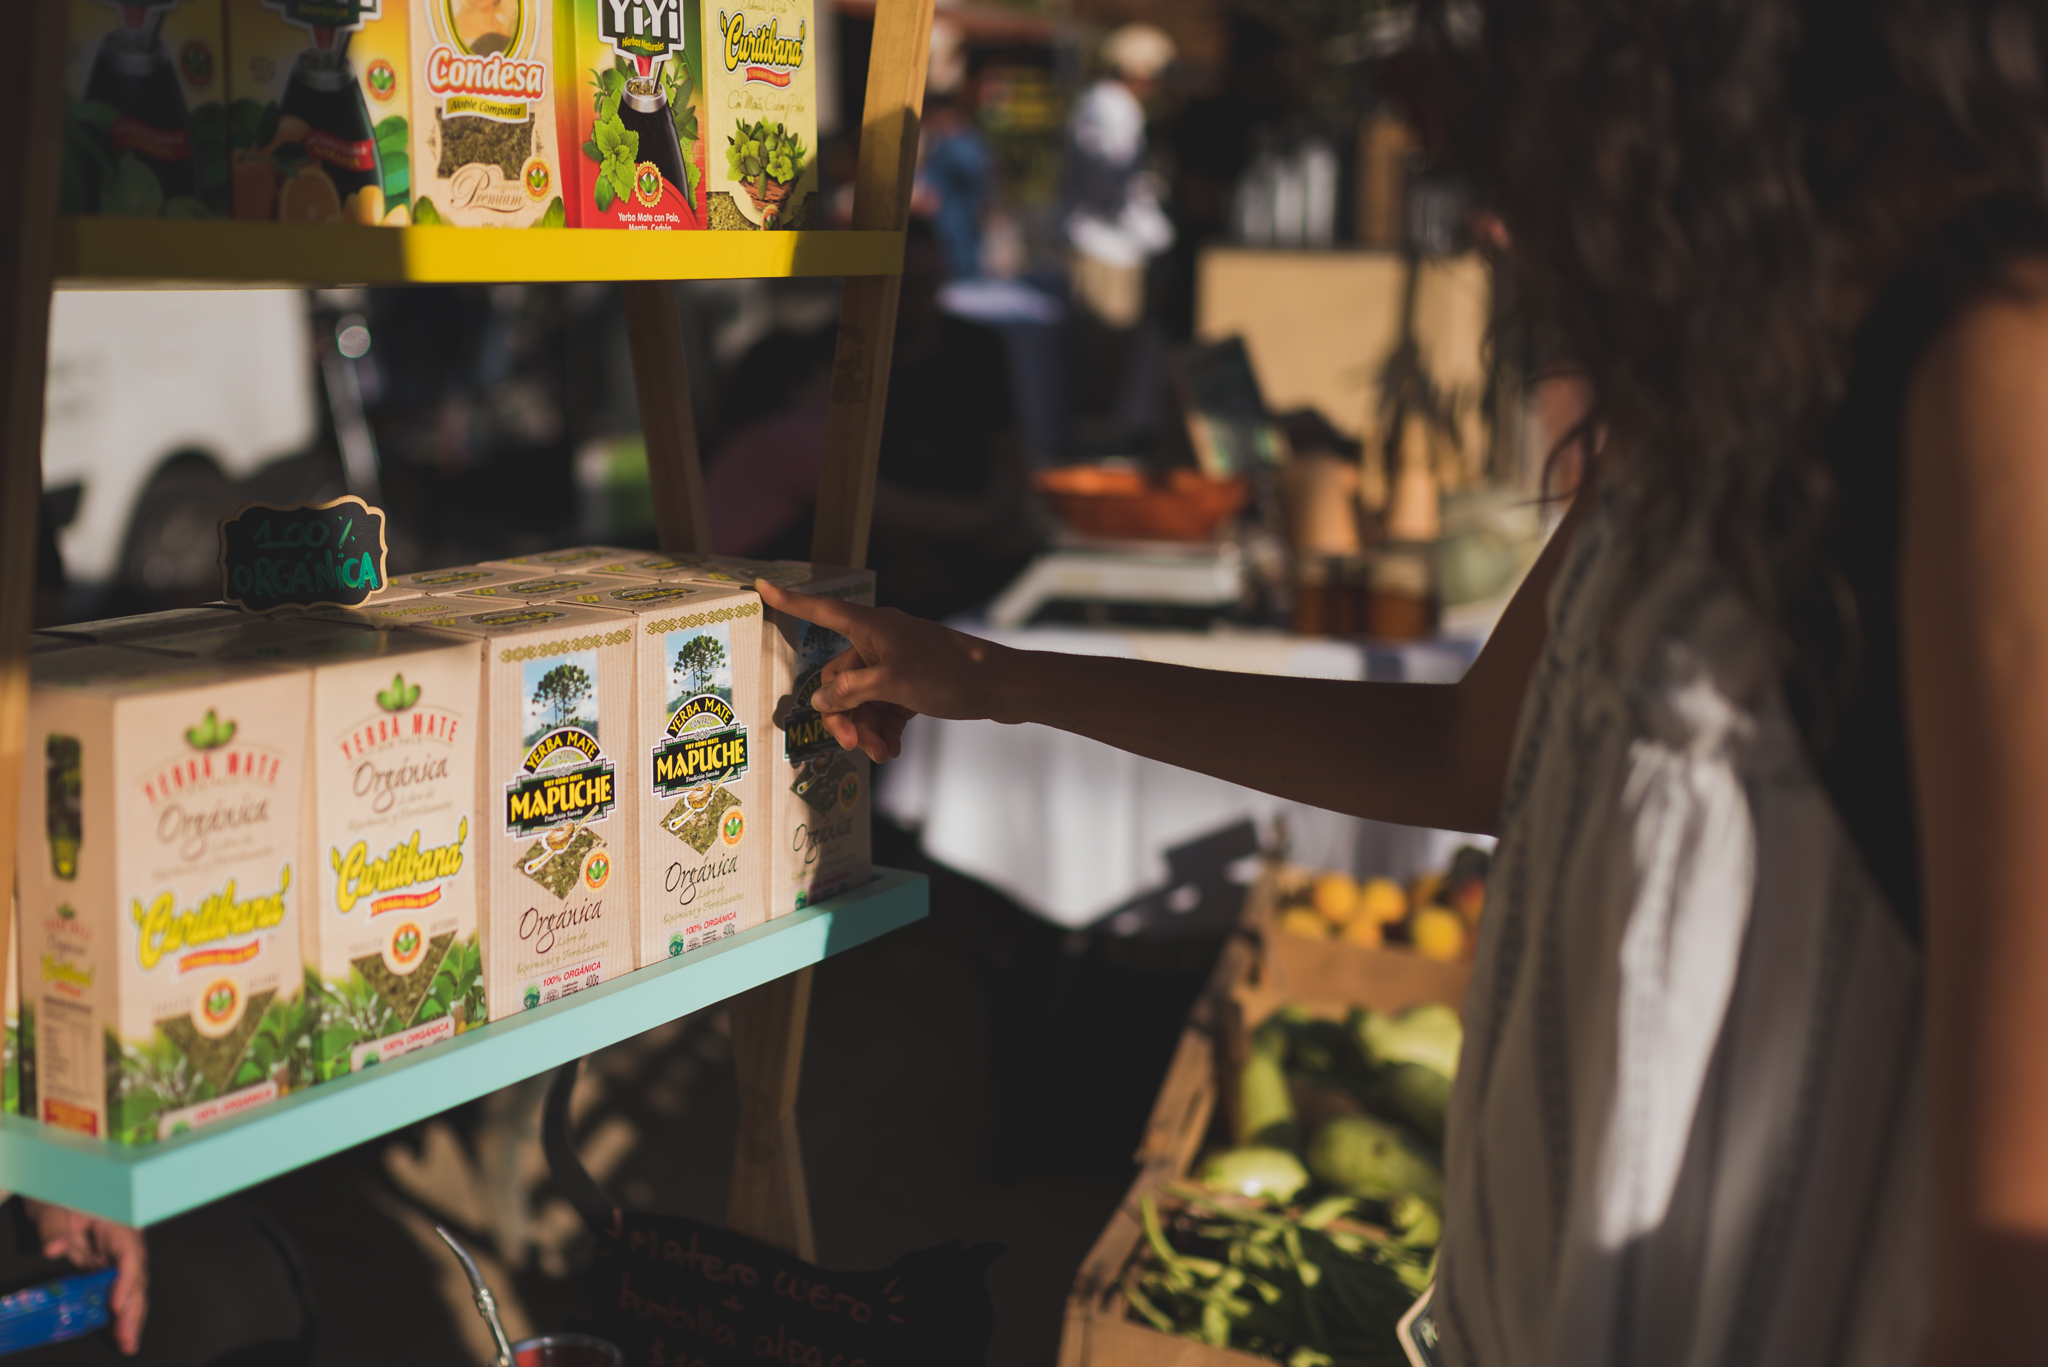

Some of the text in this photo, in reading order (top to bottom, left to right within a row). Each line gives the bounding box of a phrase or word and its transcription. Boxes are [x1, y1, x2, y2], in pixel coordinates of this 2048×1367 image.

[622, 36, 665, 52] Hierbas Naturales
[428, 47, 544, 99] Condesa
[451, 99, 521, 117] Noble Compañía
[451, 163, 526, 213] Premium
[618, 212, 680, 223] Yerba Mate con Palo,
[340, 715, 399, 761] YERBA
[413, 713, 458, 742] MATE
[669, 698, 732, 733] YERBA MATE
[526, 731, 597, 769] YERBA MATE
[657, 738, 745, 782] MAPUCHE
[353, 753, 449, 814] Orgánica
[510, 775, 612, 822] MAPUCHE
[334, 824, 466, 913] Curitibana
[665, 853, 738, 905] Orgánica
[717, 882, 725, 893] de
[519, 898, 602, 954] Orgánica
[578, 928, 588, 939] de
[686, 911, 737, 936] 100% ORGÁNICA
[543, 961, 601, 987] 100% ORGÁNICA
[629, 1227, 873, 1324] Matero cuero
